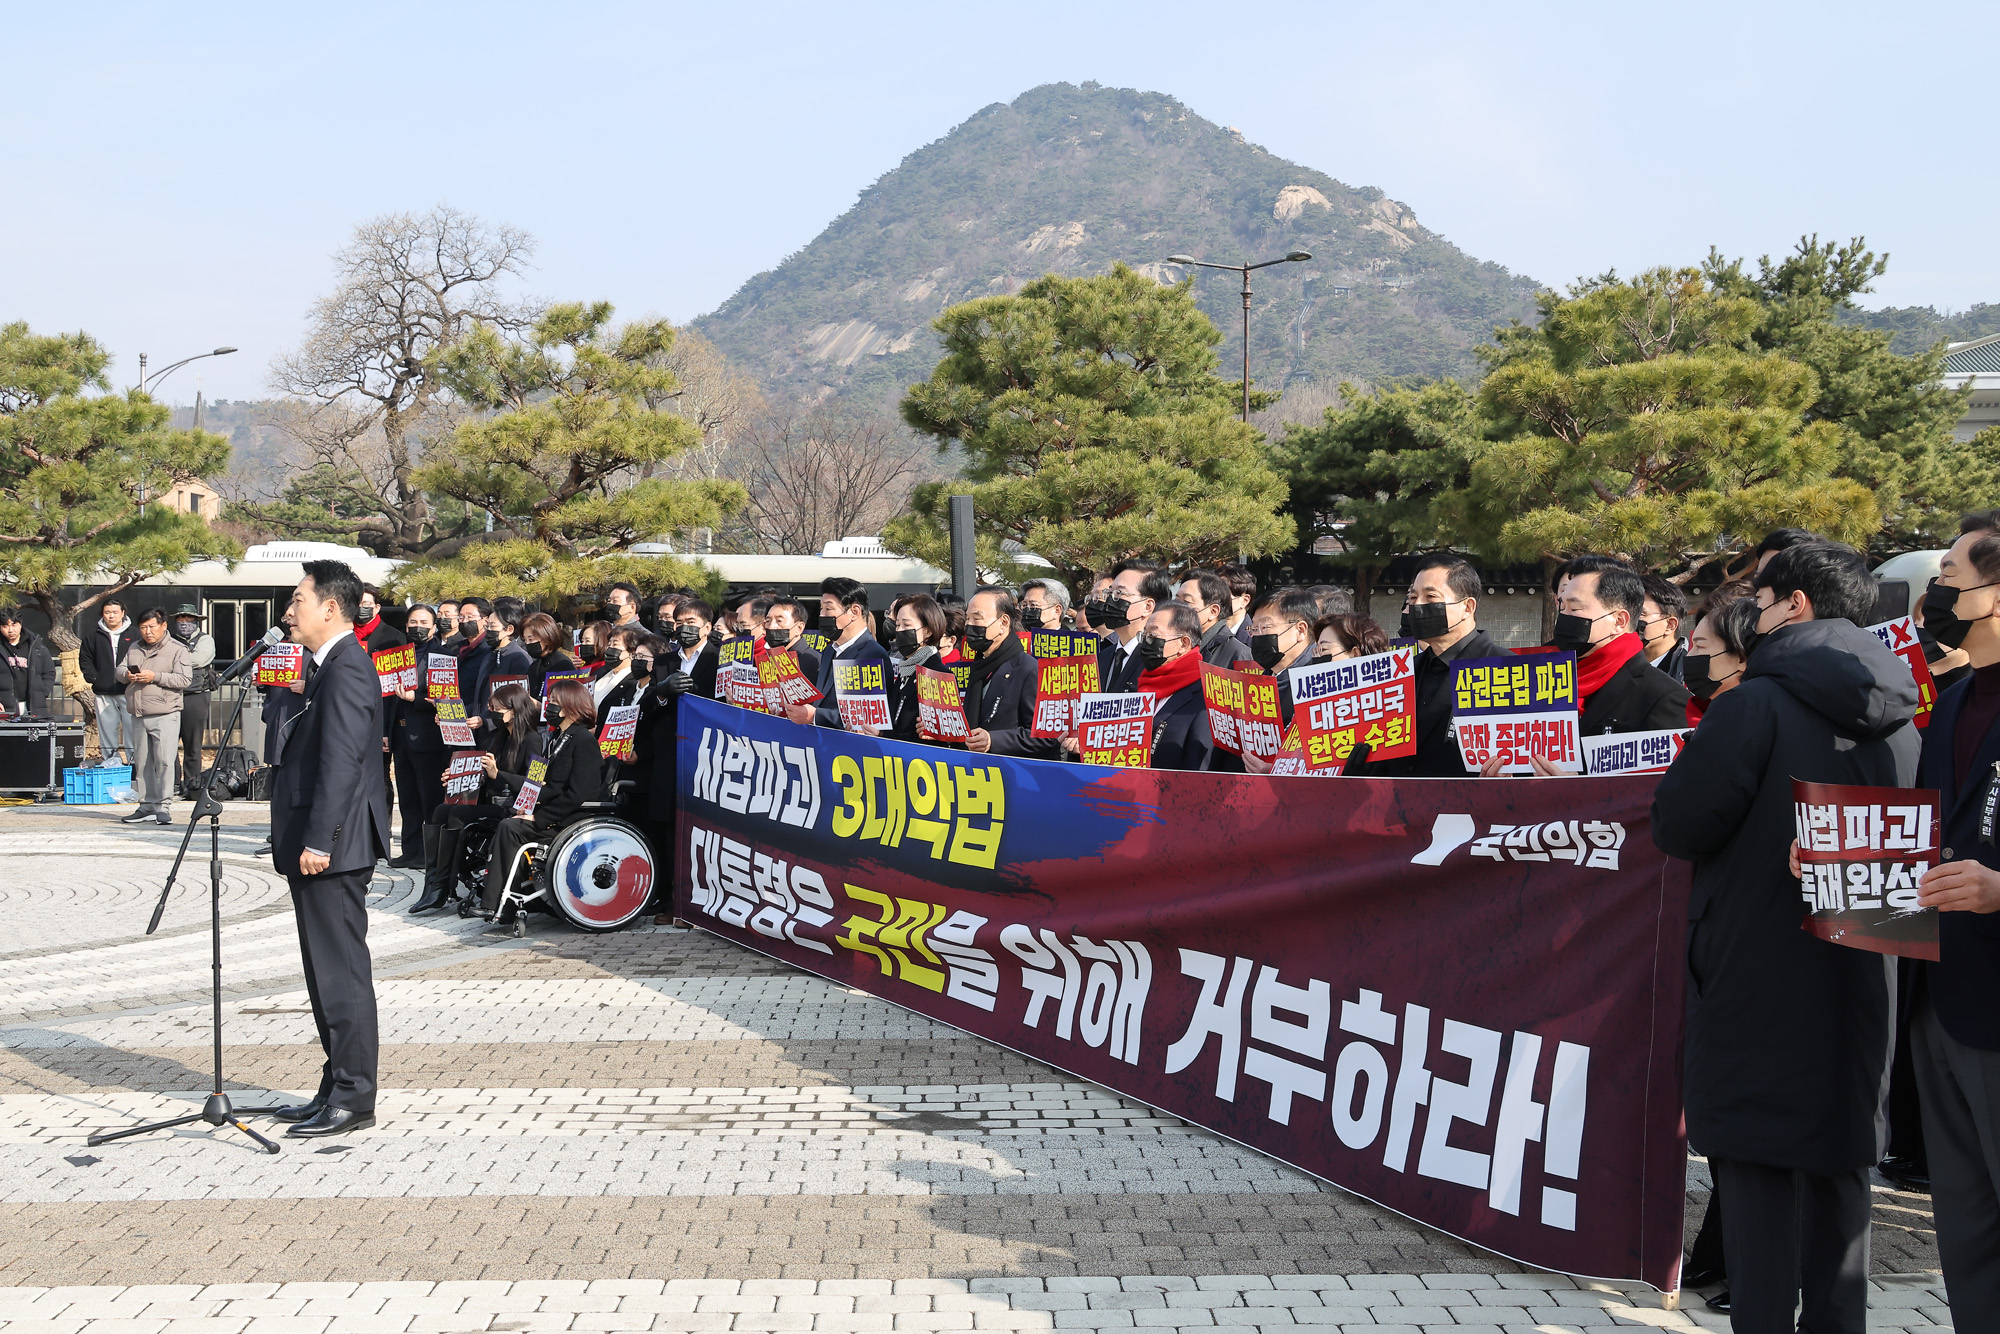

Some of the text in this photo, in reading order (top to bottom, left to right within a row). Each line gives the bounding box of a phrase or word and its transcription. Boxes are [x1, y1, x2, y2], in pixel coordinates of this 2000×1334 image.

[260, 656, 297, 671] 대한민국
[376, 647, 416, 673] 사법파괴 3법
[735, 639, 753, 662] 파괴
[1033, 633, 1071, 659] 삼권분립
[1073, 636, 1098, 657] 파괴
[259, 670, 276, 683] 헌정
[430, 670, 456, 685] 대한민국
[774, 652, 799, 677] 3법
[834, 664, 861, 691] 삼권분립
[861, 664, 884, 691] 파괴
[1040, 661, 1099, 696] 사법파괴 3법
[1296, 656, 1392, 700] 사법파괴 악법
[429, 684, 443, 698] 헌정
[917, 672, 960, 707] 사법파괴 3법
[1205, 671, 1278, 719] 사법파괴 3법
[1455, 660, 1573, 709] 삼권분립 파괴
[849, 698, 889, 726] 중단하라!
[1035, 698, 1070, 733] 대통령은
[1082, 699, 1123, 720] 사법파괴
[1123, 696, 1142, 717] 악법
[1309, 684, 1405, 731] 대한민국
[1086, 721, 1146, 749] 대한민국
[1208, 707, 1240, 751] 대통령은
[1235, 718, 1283, 757] 거부하라!
[1307, 728, 1356, 765] 헌정
[1364, 714, 1412, 752] 수호!
[1459, 723, 1491, 766] 당장
[1496, 719, 1576, 766] 중단하라!
[1590, 734, 1671, 775] 사법파괴 악법
[692, 727, 1006, 870] 사법파괴 3대악법
[1470, 819, 1627, 871] 국민의힘
[689, 825, 1591, 1232] 대통령은 국민을 위해 거부하라!
